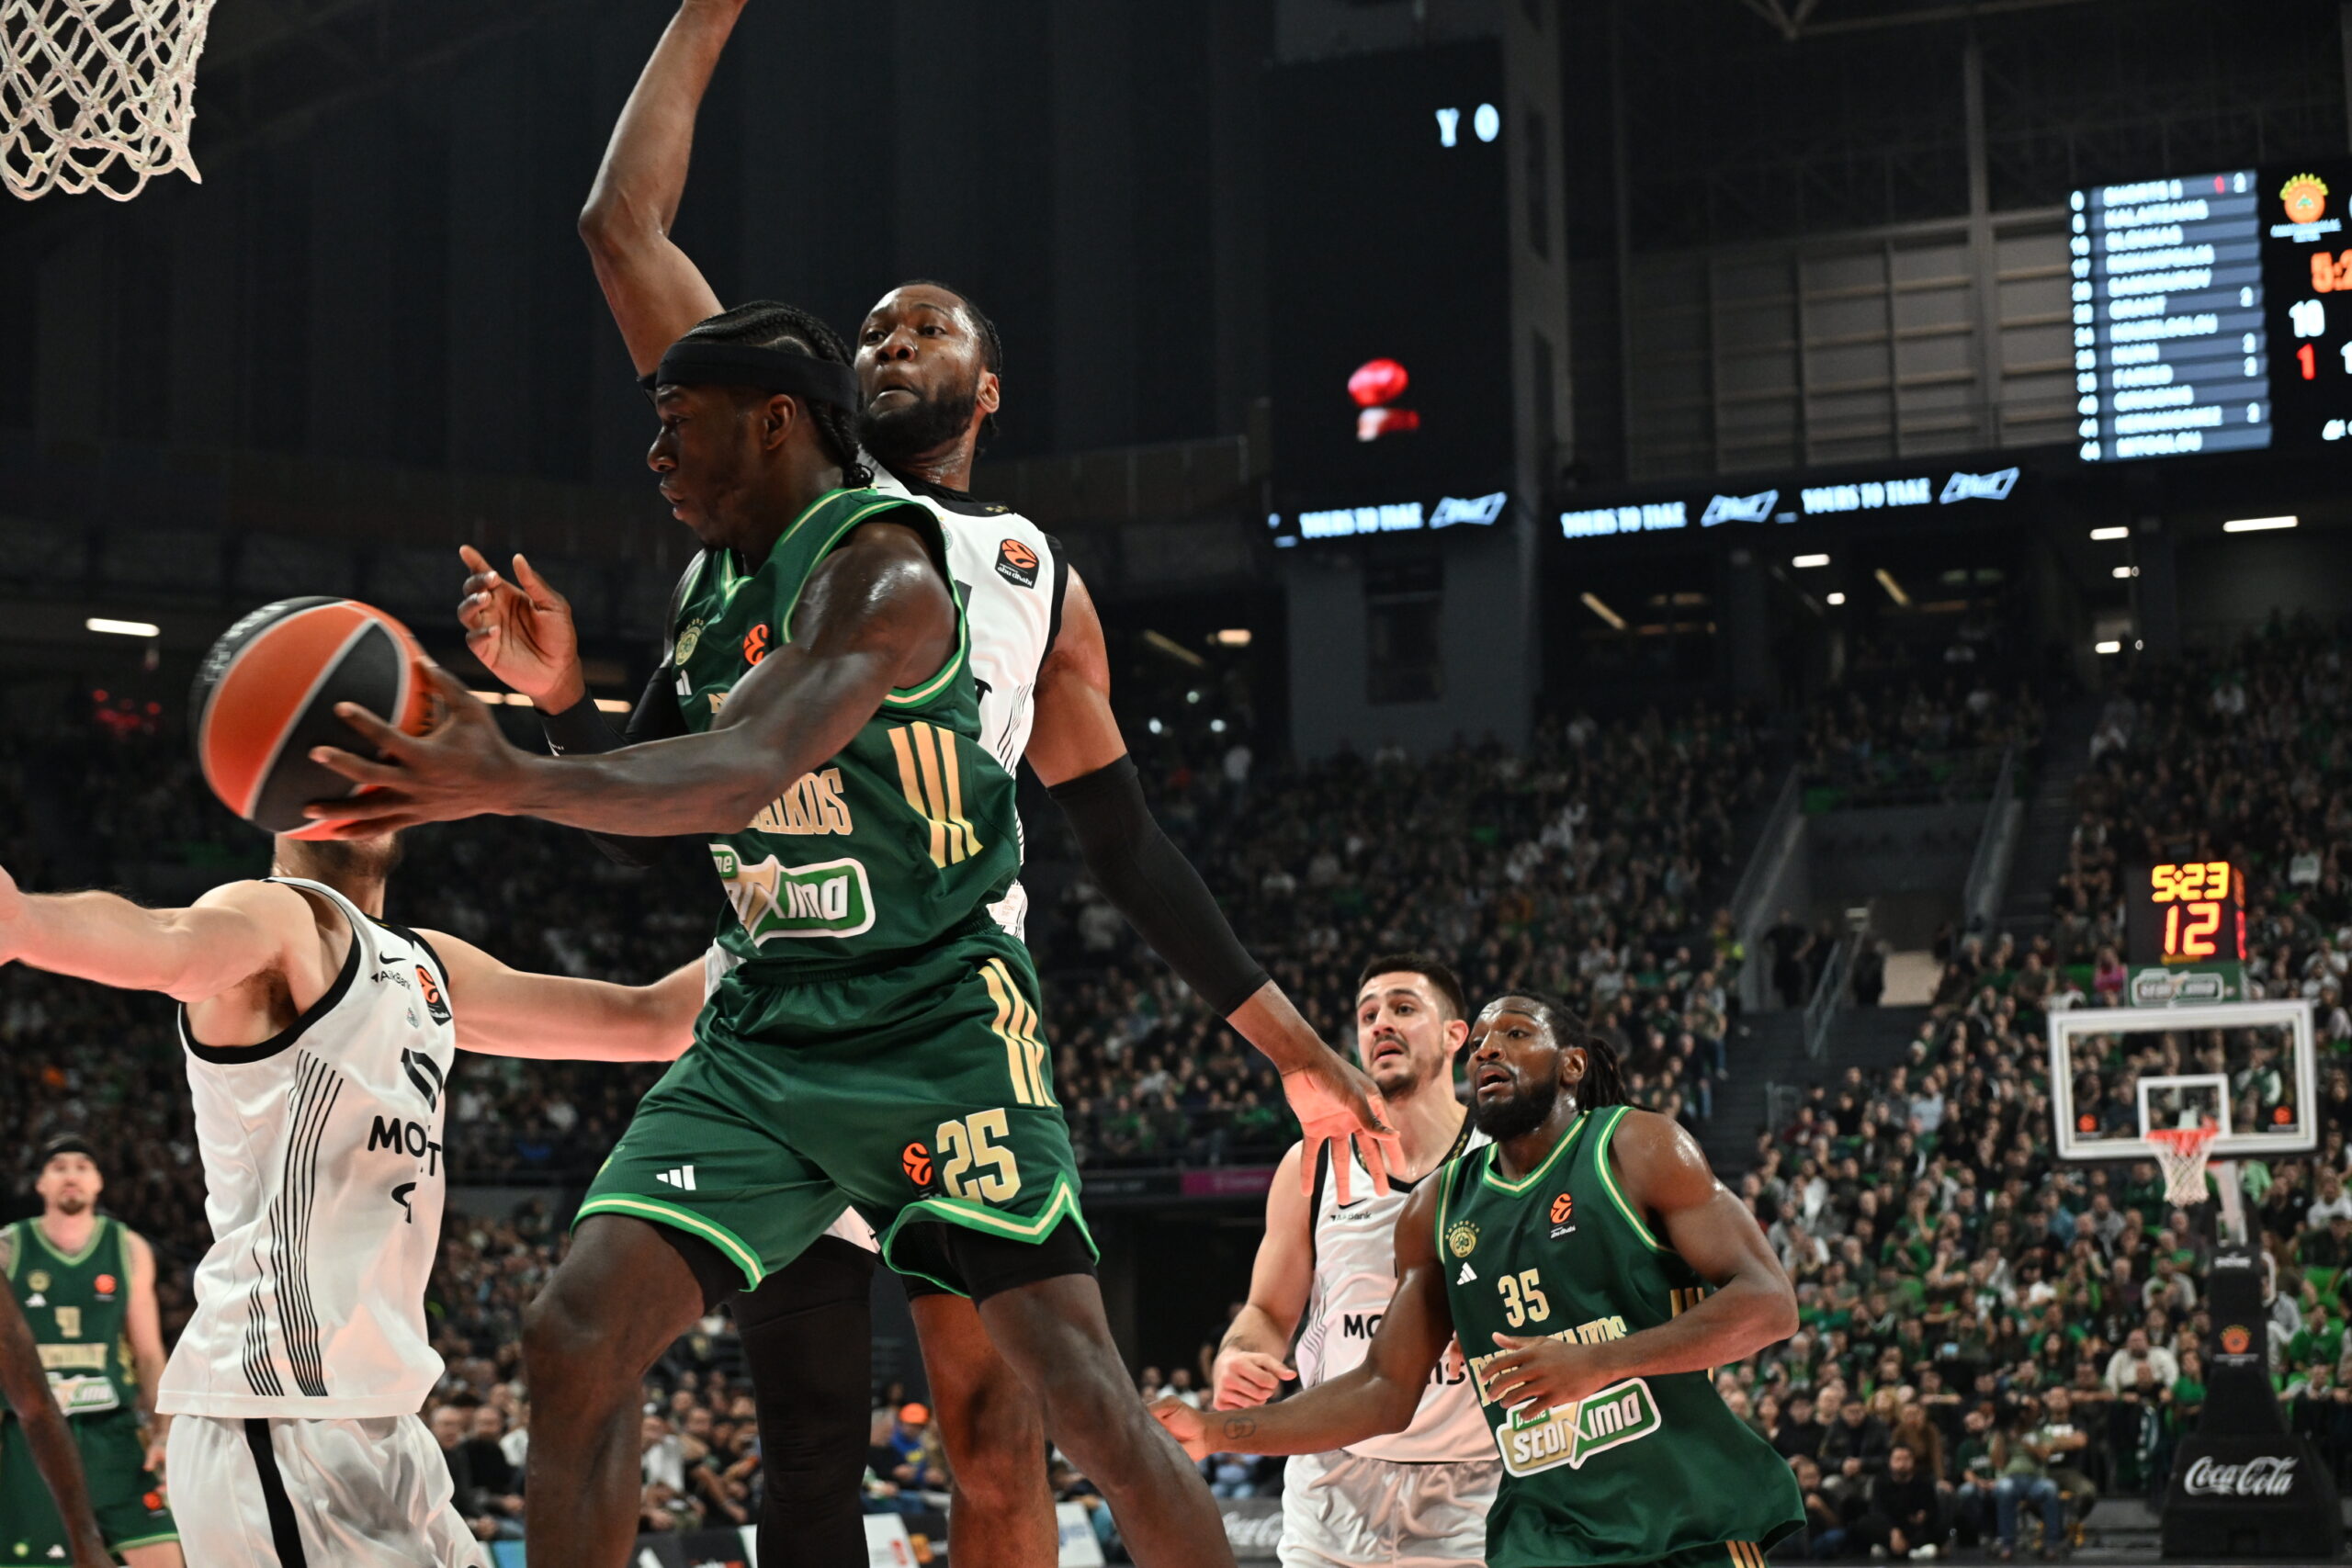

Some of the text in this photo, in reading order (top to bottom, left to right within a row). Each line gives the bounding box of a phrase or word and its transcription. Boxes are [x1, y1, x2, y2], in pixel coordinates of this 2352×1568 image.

[2151, 862, 2229, 902] 5:23
[2164, 902, 2220, 955] 12
[935, 1108, 1022, 1205] 25
[1498, 1269, 1551, 1328] 35
